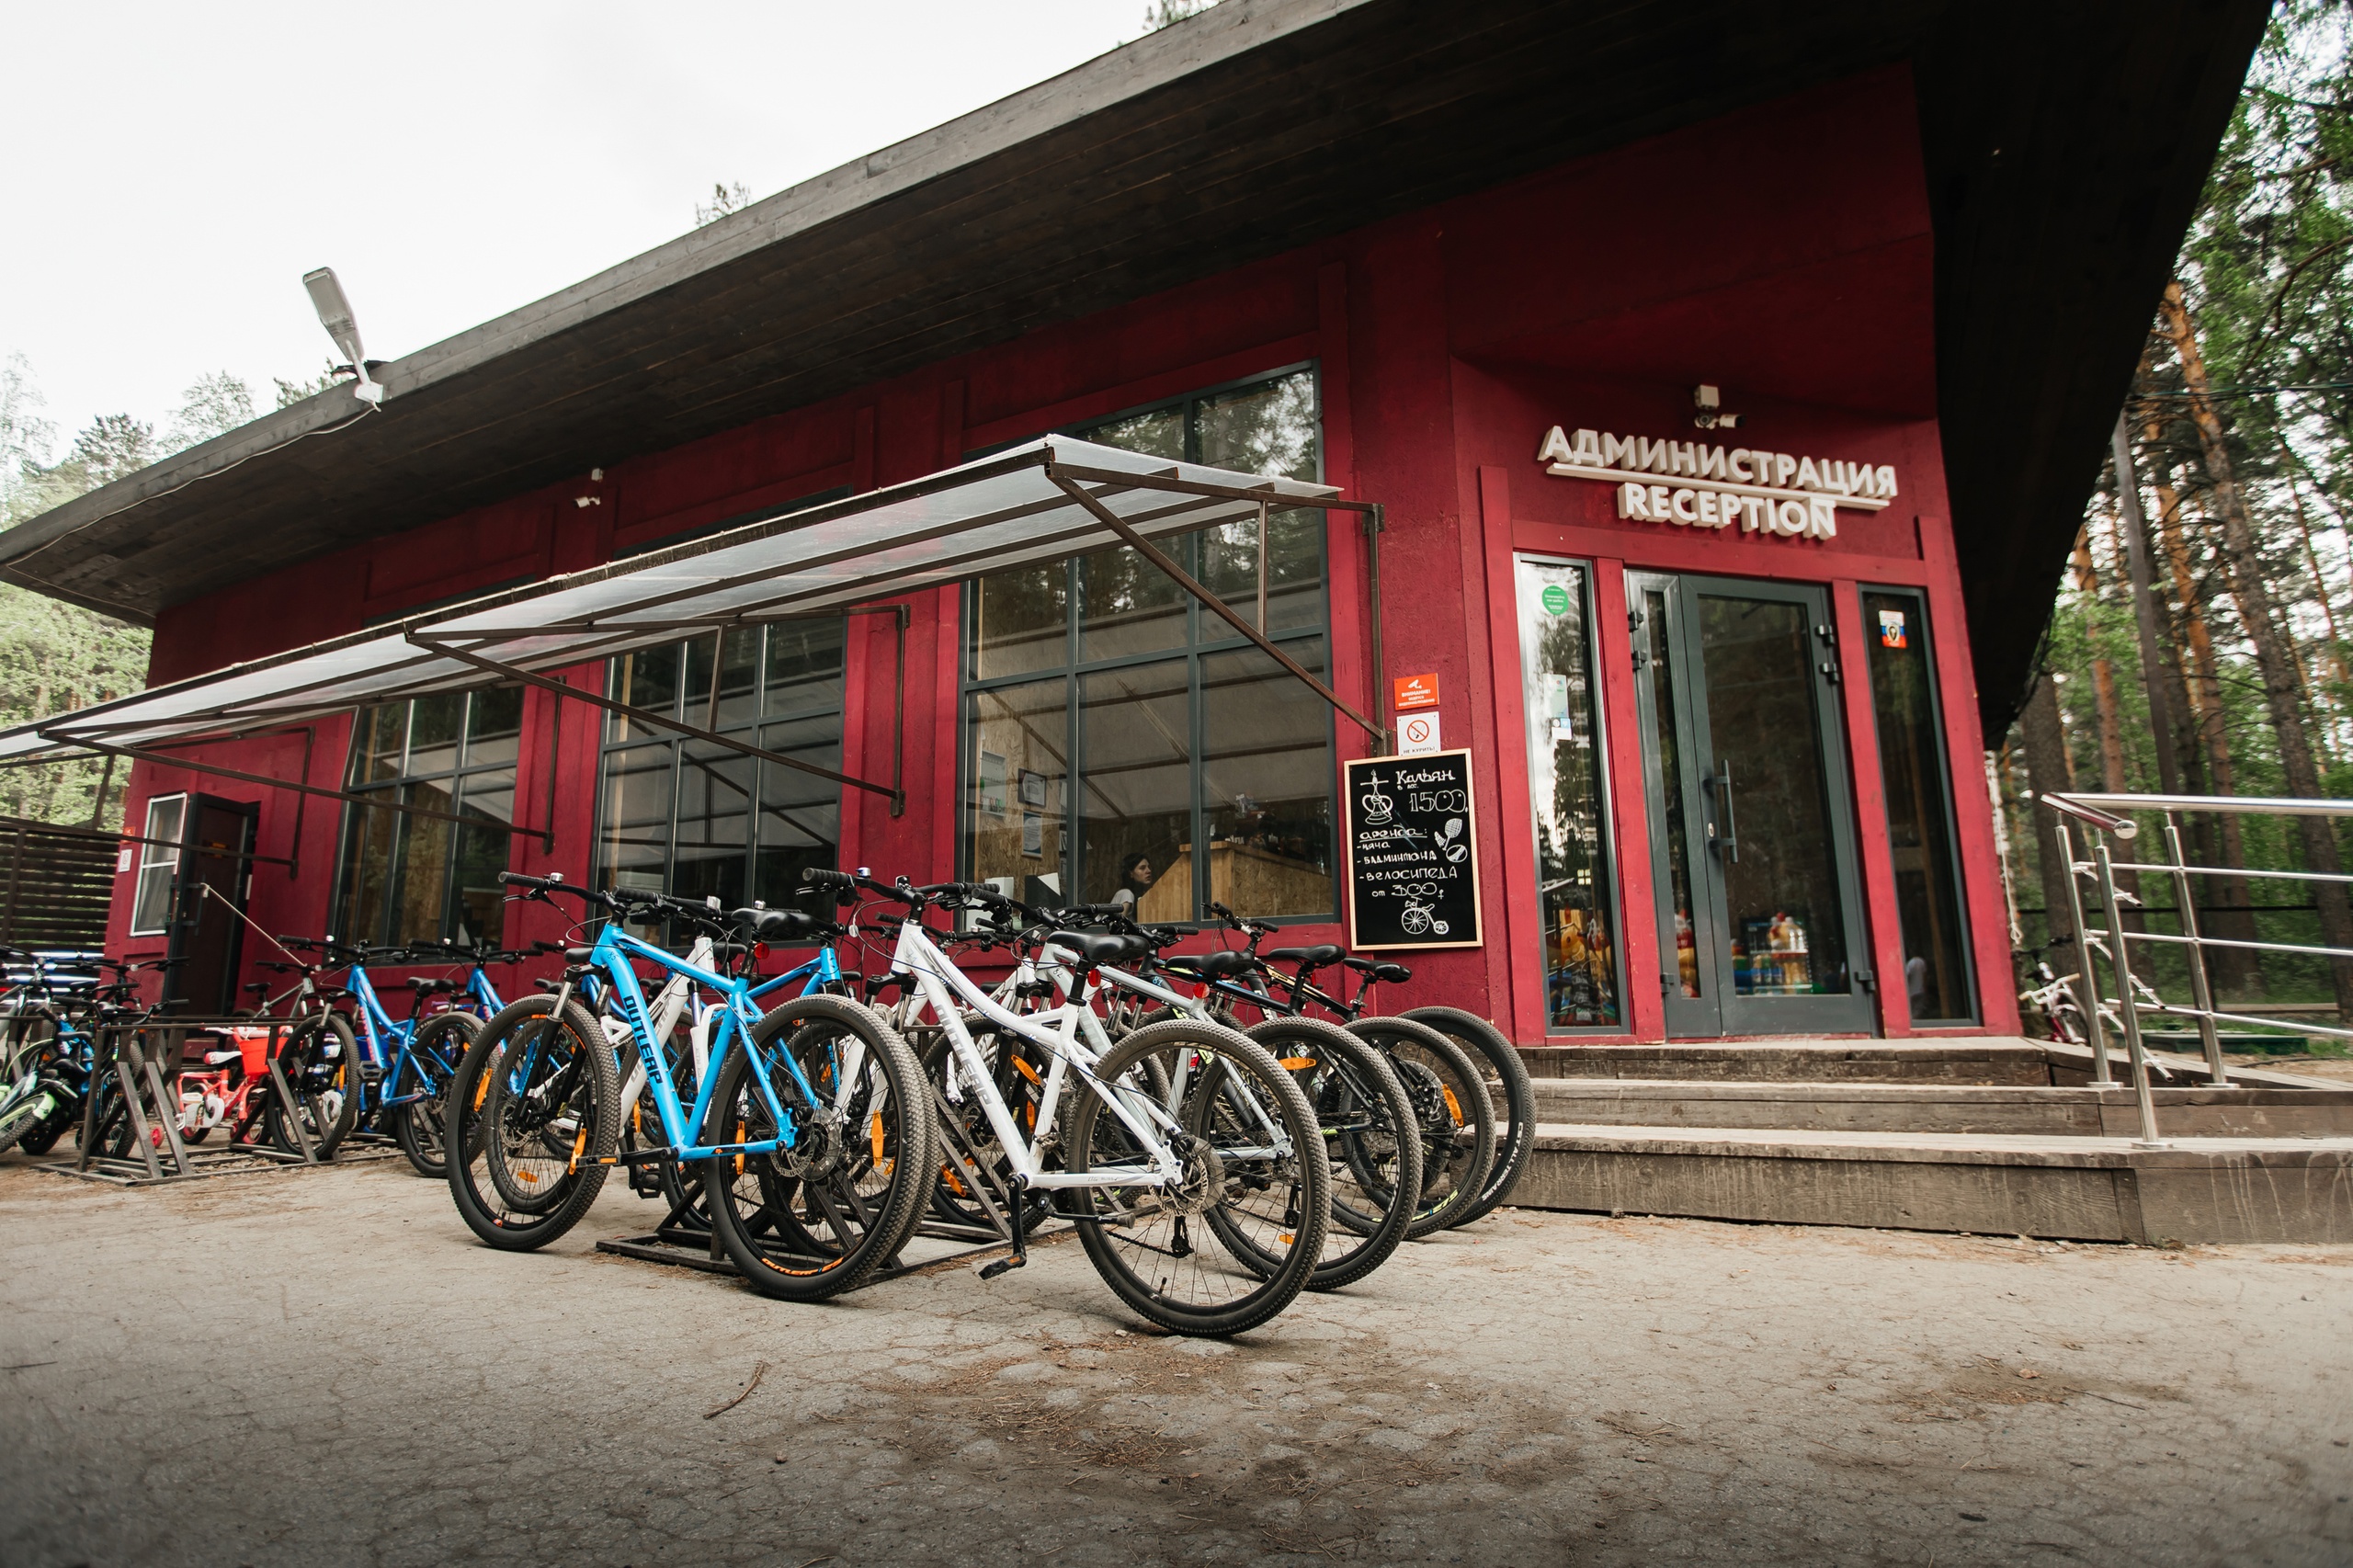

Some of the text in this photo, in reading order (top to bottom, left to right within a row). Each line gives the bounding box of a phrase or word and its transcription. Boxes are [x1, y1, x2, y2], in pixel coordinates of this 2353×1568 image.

[1538, 426, 1898, 499] АДМИНИСТРАЦИЯ
[1618, 483, 1836, 540] RECEPTION
[1395, 768, 1456, 785] Кальян
[623, 994, 664, 1084] OUTLEAP
[935, 1005, 993, 1105] OUTLEAP
